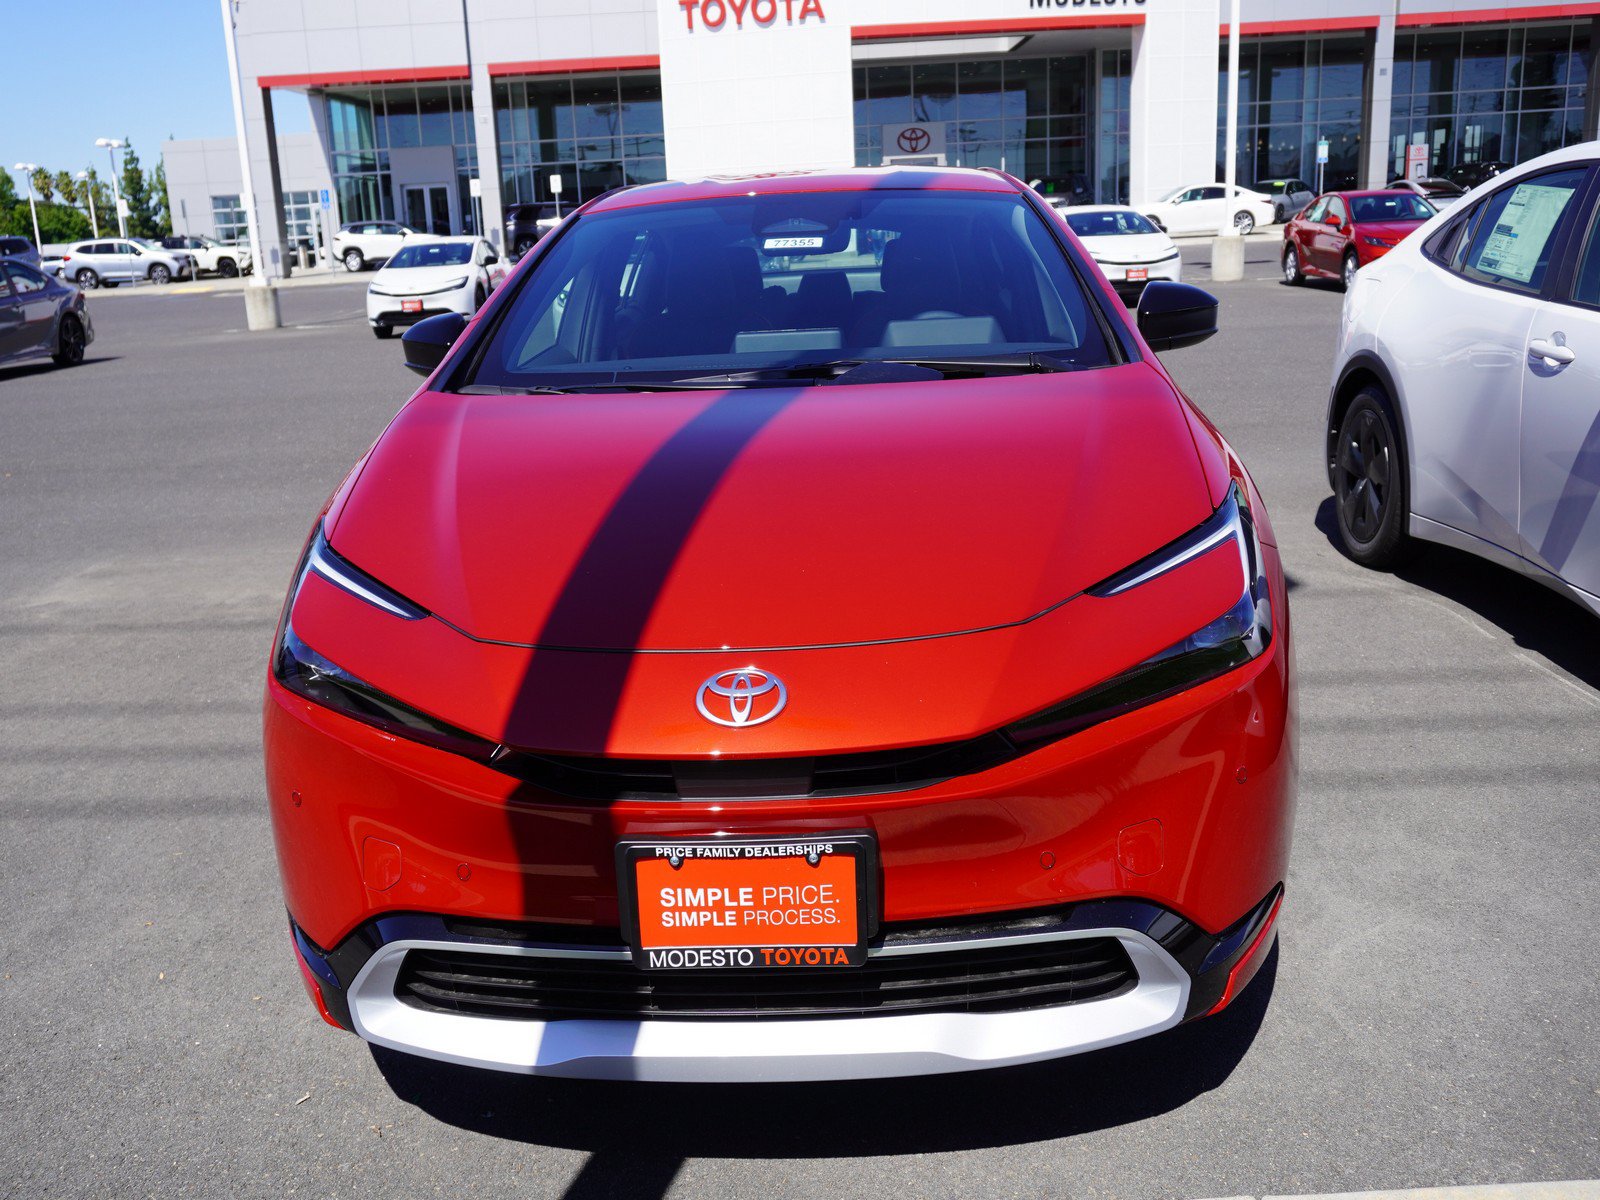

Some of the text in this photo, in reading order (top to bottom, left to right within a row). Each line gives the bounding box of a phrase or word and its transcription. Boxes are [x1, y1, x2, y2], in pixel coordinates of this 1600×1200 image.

[678, 0, 825, 30] TOYOTA
[774, 238, 815, 247] 77355
[655, 844, 834, 858] PRICE FAMILY DEALERSHIPS
[660, 884, 841, 908] SIMPLE PRICE.
[661, 907, 842, 928] SIMPLE PROCESS.
[649, 947, 849, 968] MODESTO TOYOTA
